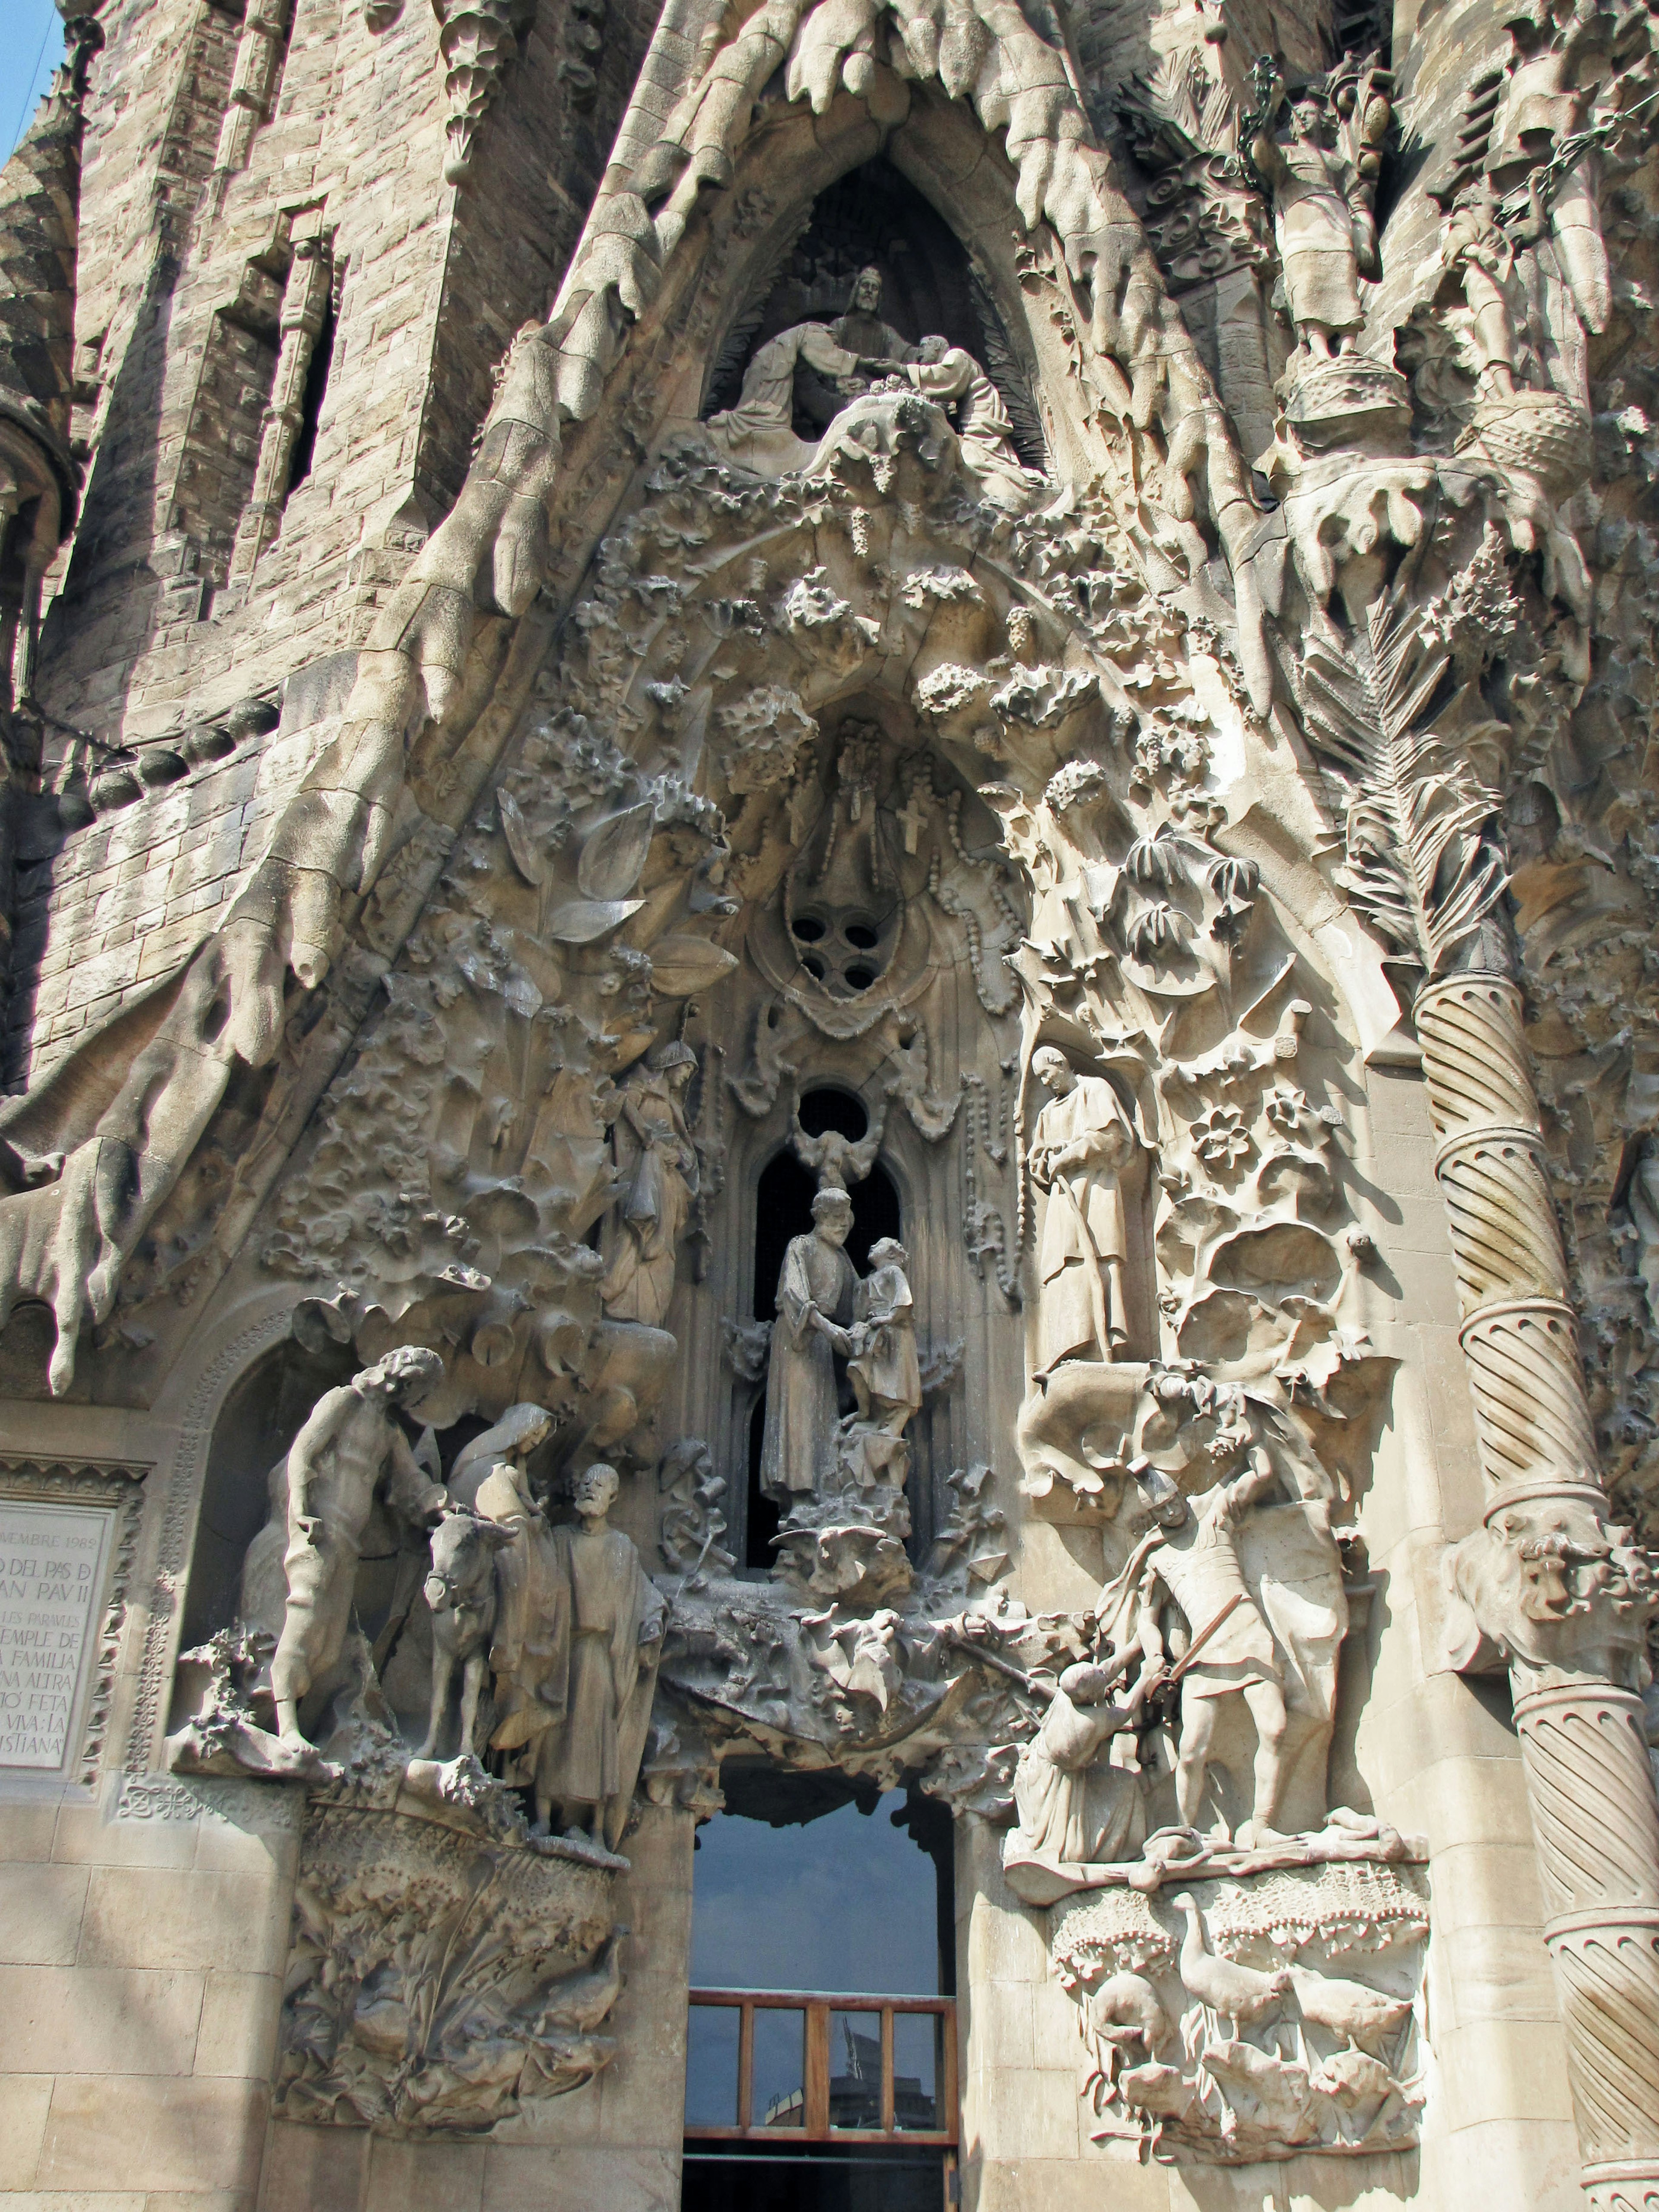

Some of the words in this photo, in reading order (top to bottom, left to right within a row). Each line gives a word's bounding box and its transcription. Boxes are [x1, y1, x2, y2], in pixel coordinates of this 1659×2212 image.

[10, 1558, 40, 1577] DEL
[45, 1561, 72, 1579] PAS
[77, 1585, 89, 1602] II
[0, 1625, 53, 1647] EMPLE
[59, 1632, 81, 1649] DE
[11, 1650, 76, 1670] FAMILIA
[25, 1672, 71, 1691] ALTRA
[29, 1694, 67, 1712] FETA
[48, 1713, 64, 1733] LA
